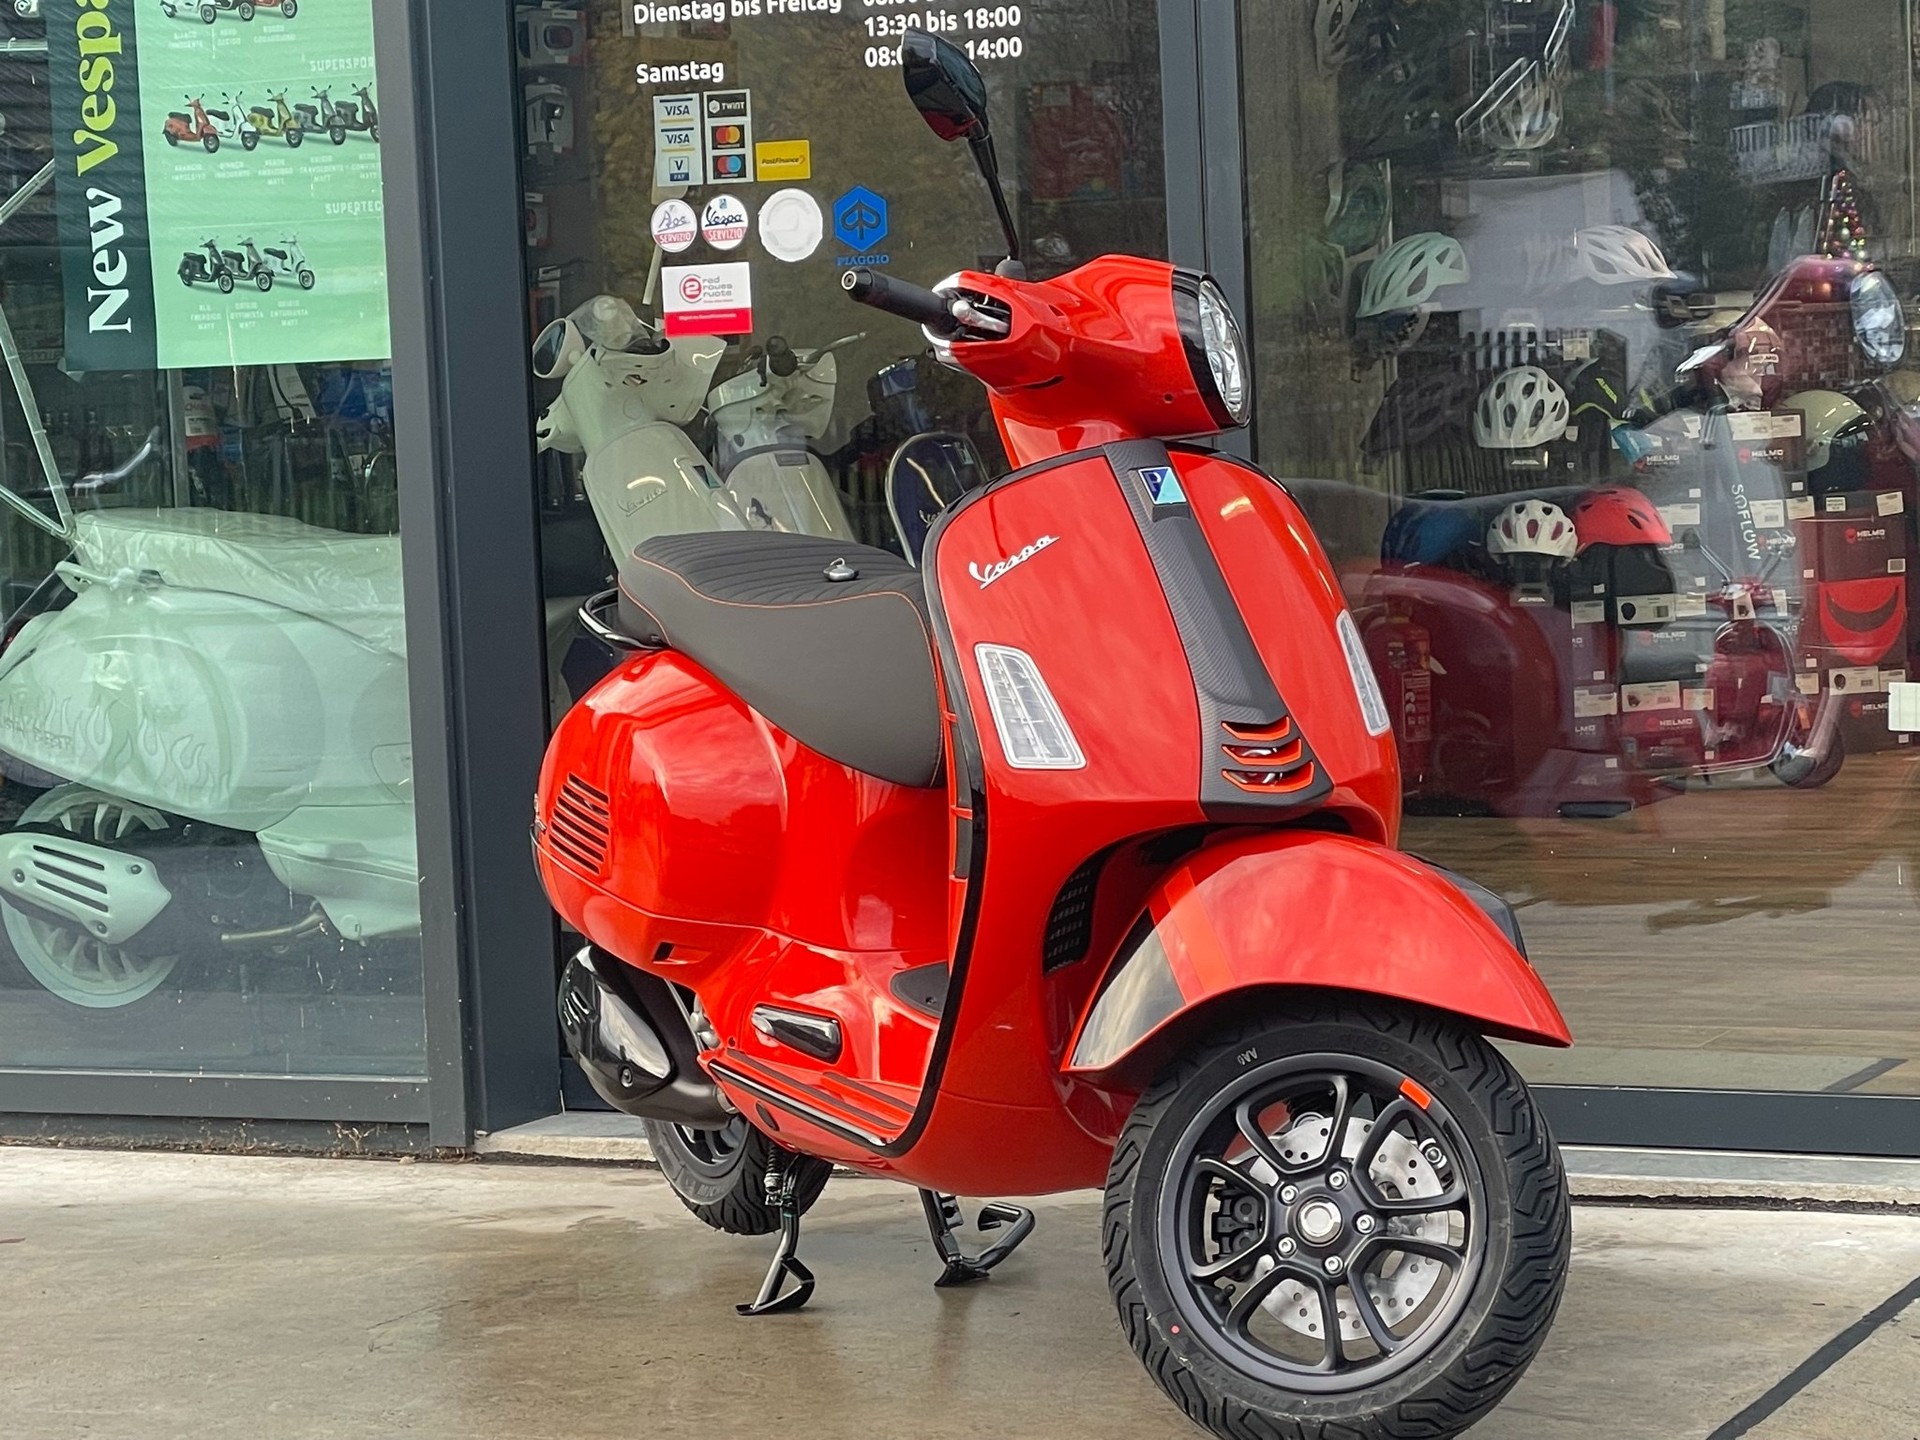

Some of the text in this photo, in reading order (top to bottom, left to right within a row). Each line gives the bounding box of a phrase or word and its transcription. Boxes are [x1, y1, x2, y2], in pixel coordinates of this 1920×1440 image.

[633, 2, 725, 25] Dienstag
[731, 0, 761, 17] bis
[864, 5, 1022, 37] 13:30 bis 18:00
[964, 36, 1023, 61] 14:00
[636, 61, 724, 84] Samstag
[664, 105, 690, 116] VISA
[721, 101, 745, 110] TWINT
[666, 133, 691, 144] VISA
[673, 160, 684, 171] V
[761, 155, 799, 165] PostFinance
[73, 0, 133, 334] New Vesp
[705, 205, 744, 227] Vespa
[659, 231, 692, 244] SERVIZIO
[708, 228, 743, 241] SERVIZIO
[837, 254, 890, 266] PIAGGIO
[702, 276, 720, 284] rad
[702, 283, 733, 291] roues
[1646, 454, 1680, 462] HELMO
[969, 535, 1061, 590] Vespa
[1659, 718, 1694, 726] HELMO
